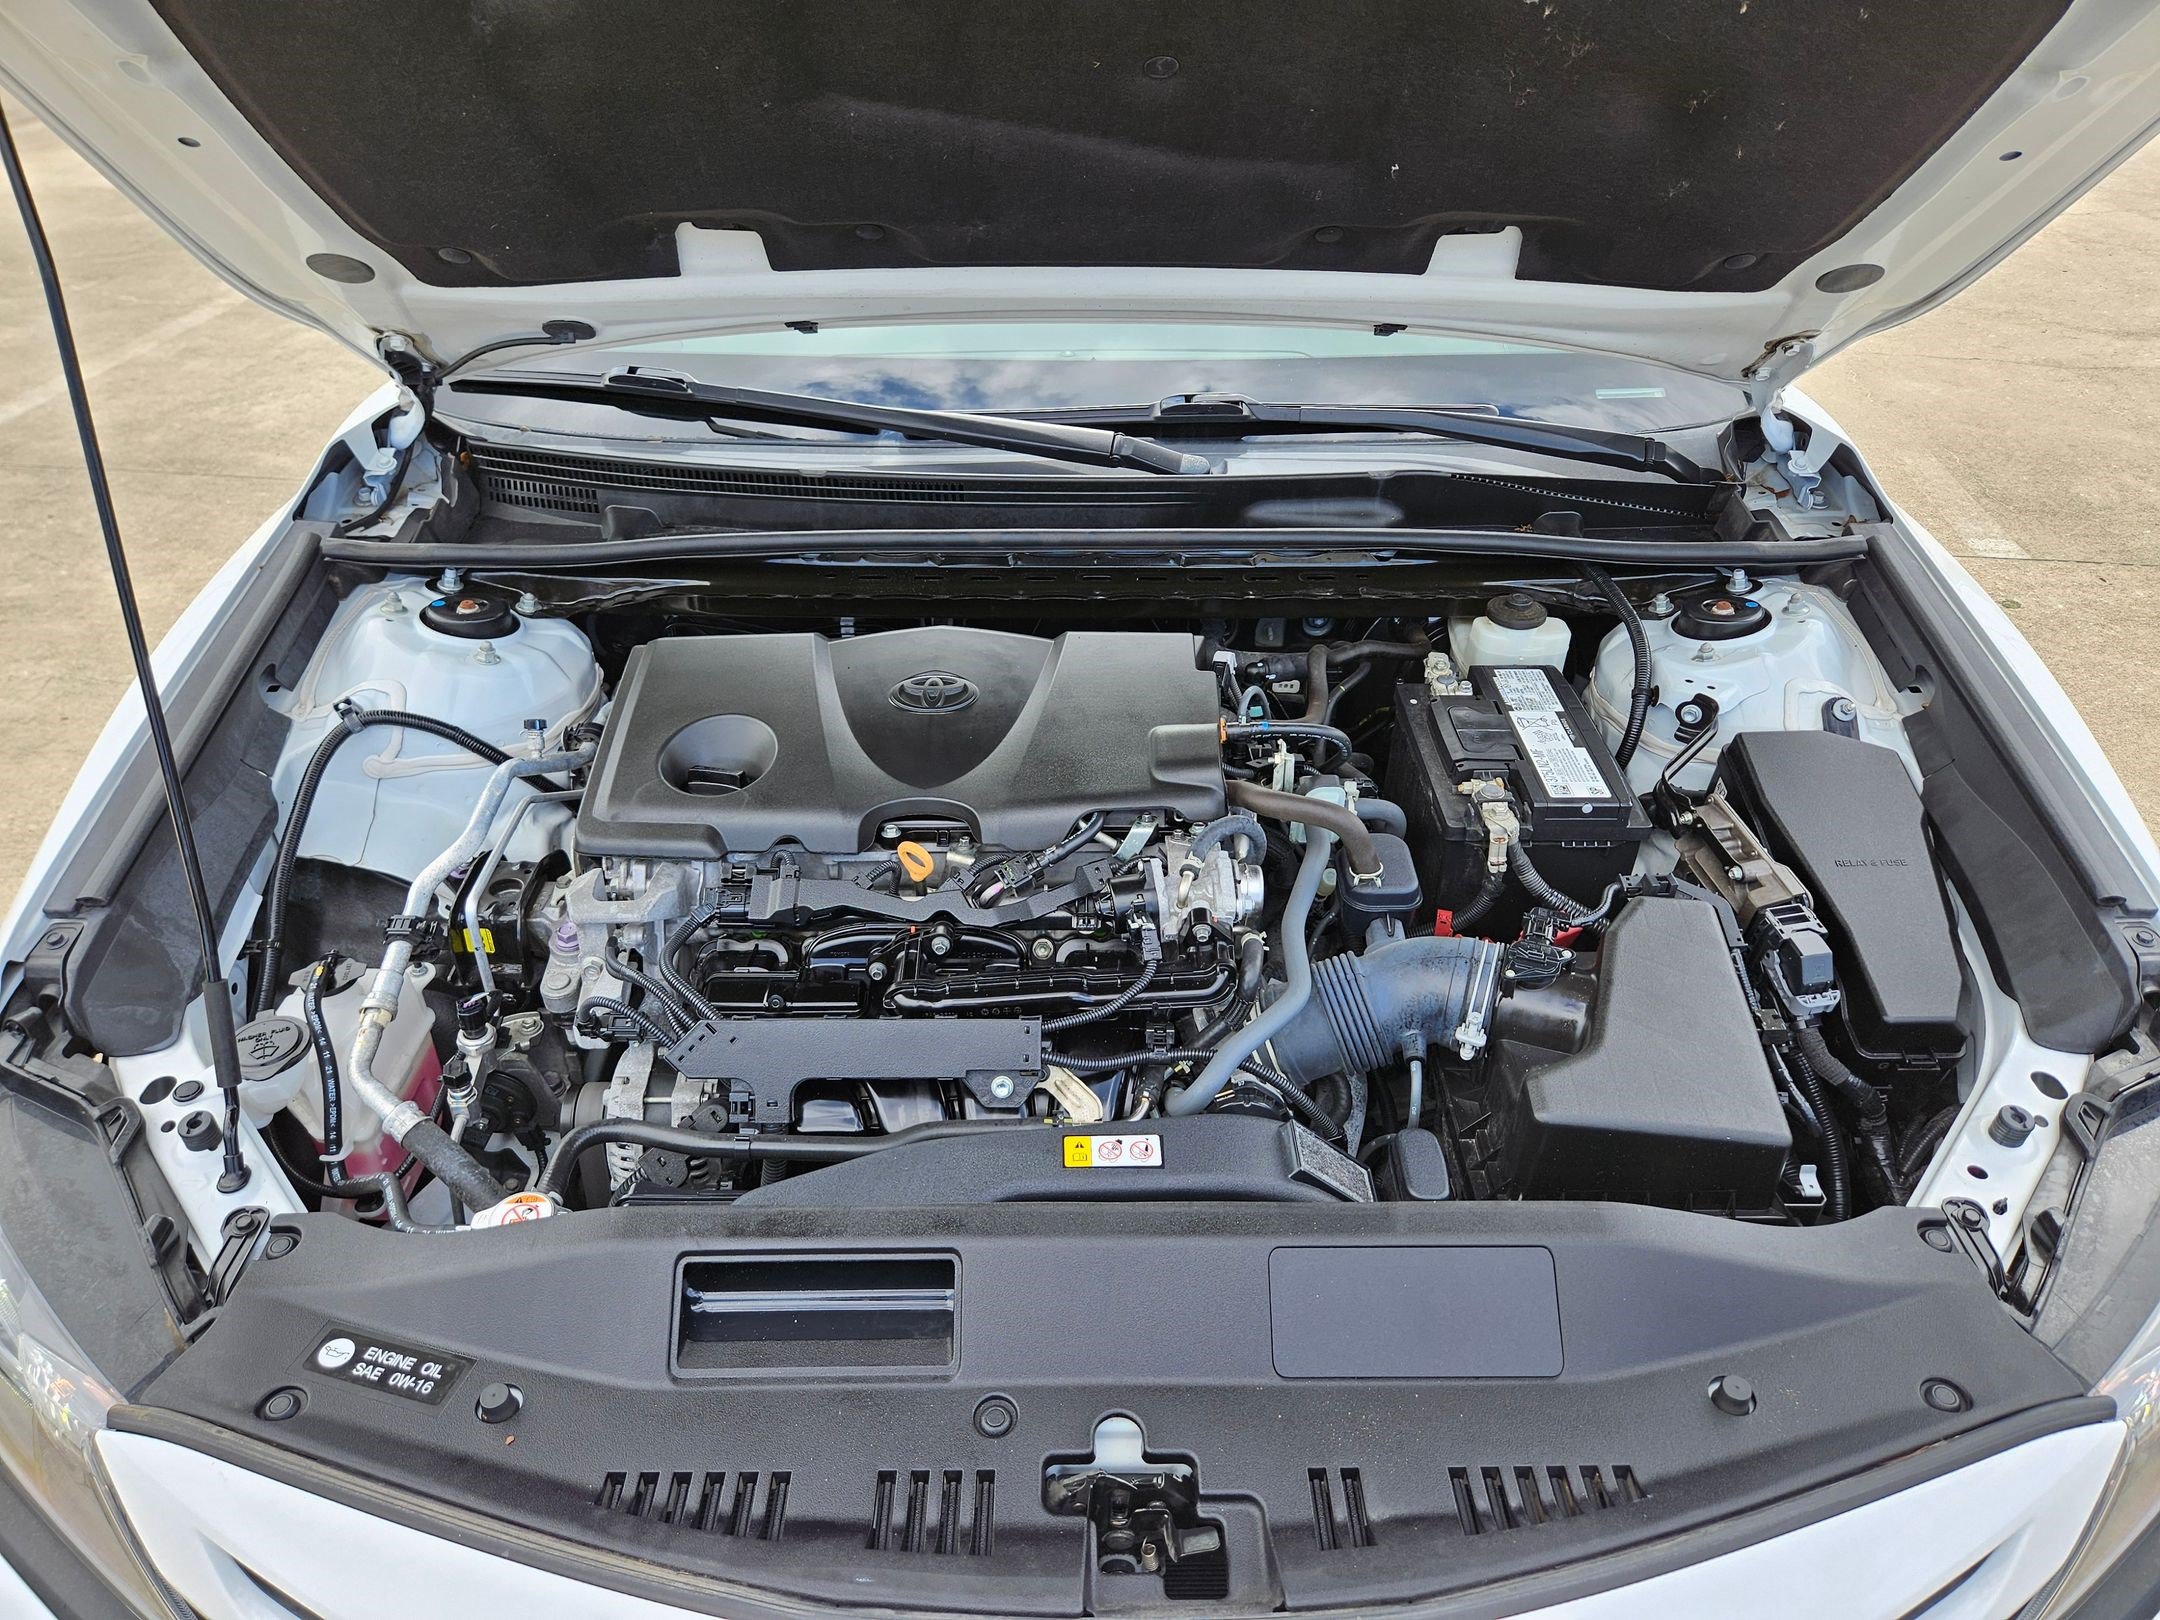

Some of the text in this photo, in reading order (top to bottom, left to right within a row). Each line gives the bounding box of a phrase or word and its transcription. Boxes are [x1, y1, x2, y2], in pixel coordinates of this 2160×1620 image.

[1834, 859, 1868, 868] RELAY
[1879, 859, 1909, 867] FUSE
[327, 1078, 337, 1102] WATER
[363, 1346, 443, 1379] ENGINE OIL
[352, 1362, 435, 1394] SAE 0W-16
